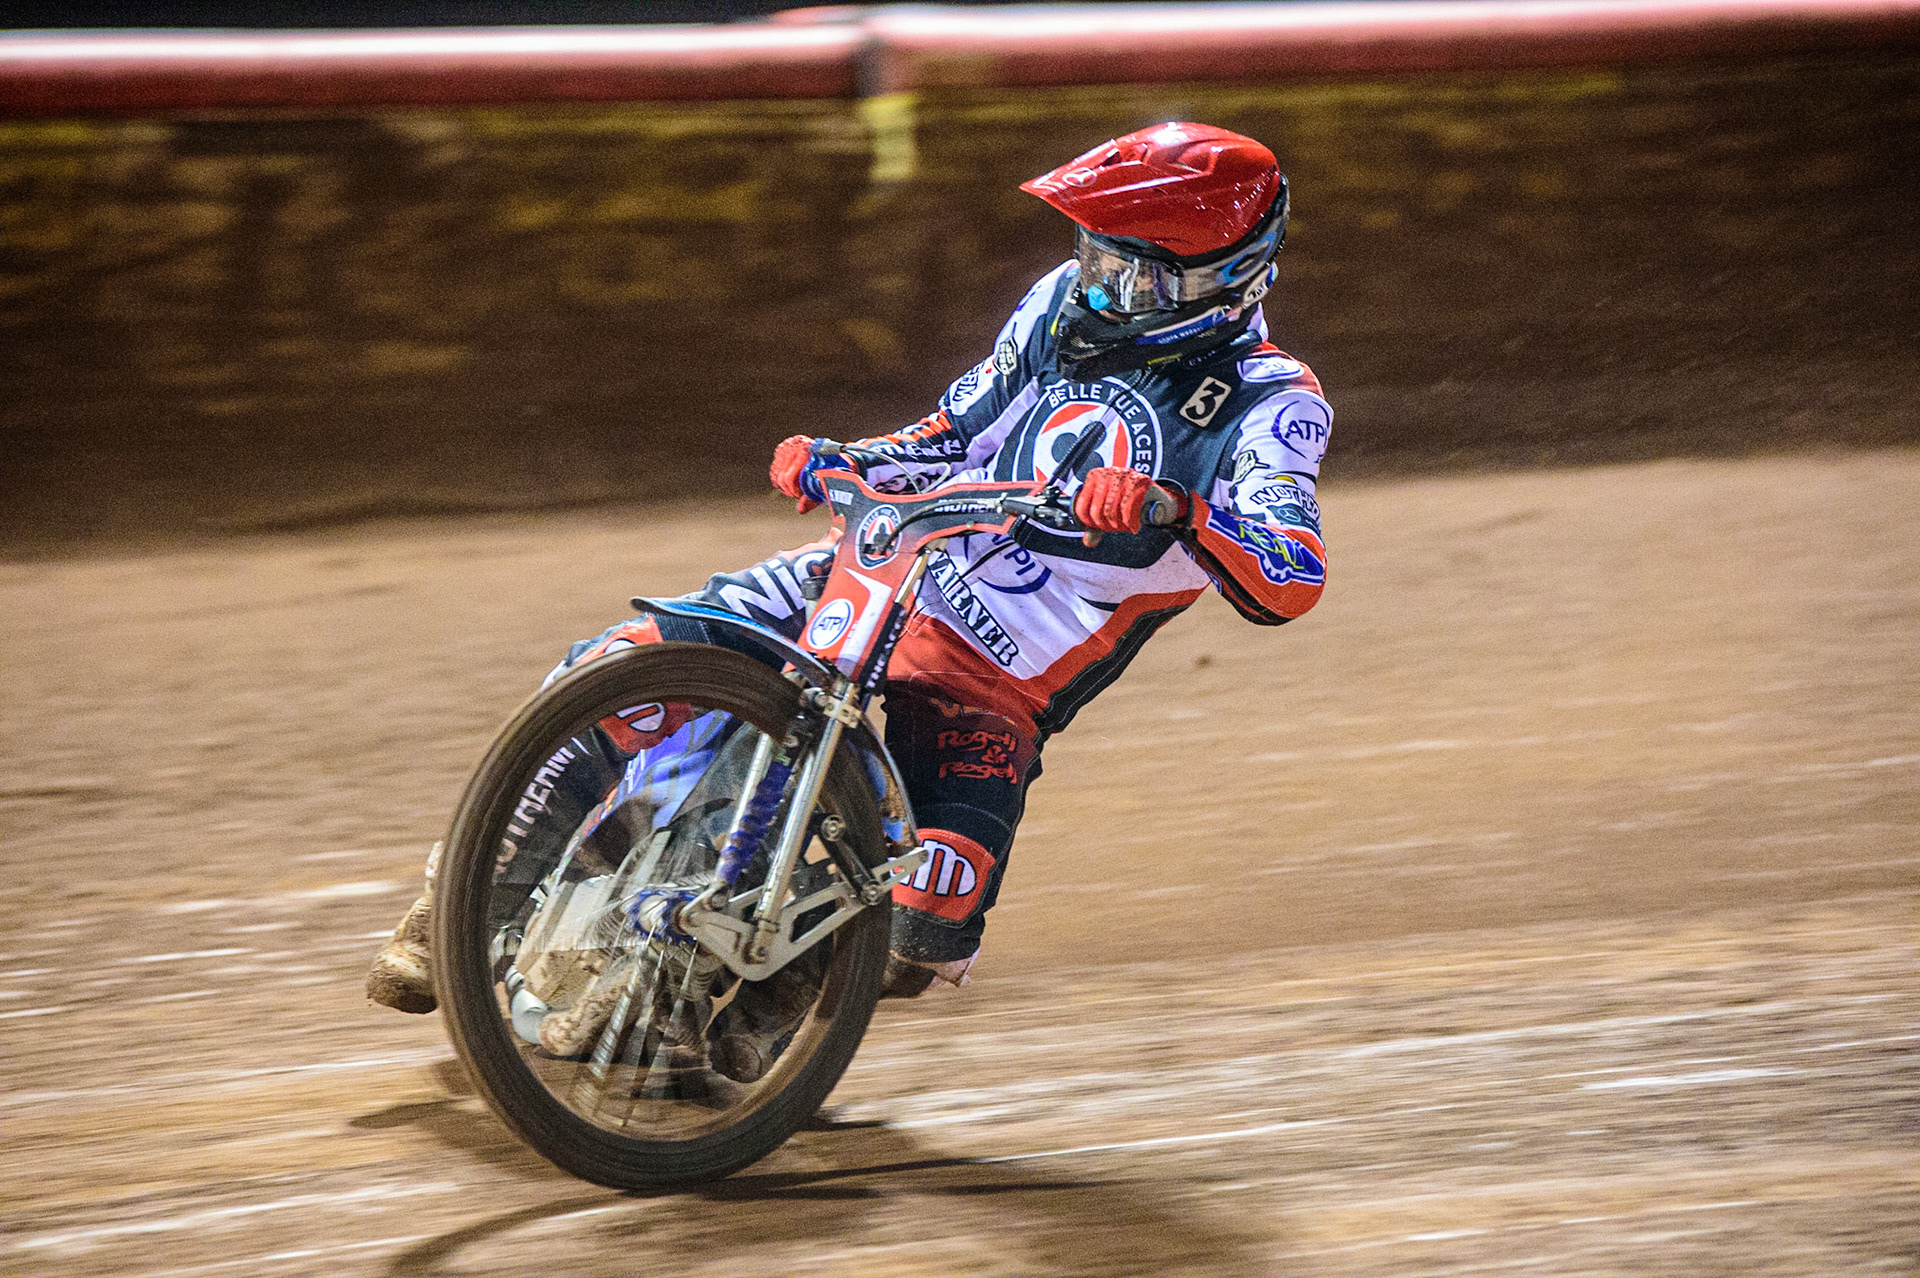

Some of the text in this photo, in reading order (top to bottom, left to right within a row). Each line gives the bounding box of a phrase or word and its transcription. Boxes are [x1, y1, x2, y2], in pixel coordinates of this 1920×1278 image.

[1048, 383, 1103, 409] BELLE
[1131, 422, 1152, 474] ACES
[1185, 381, 1226, 420] 3
